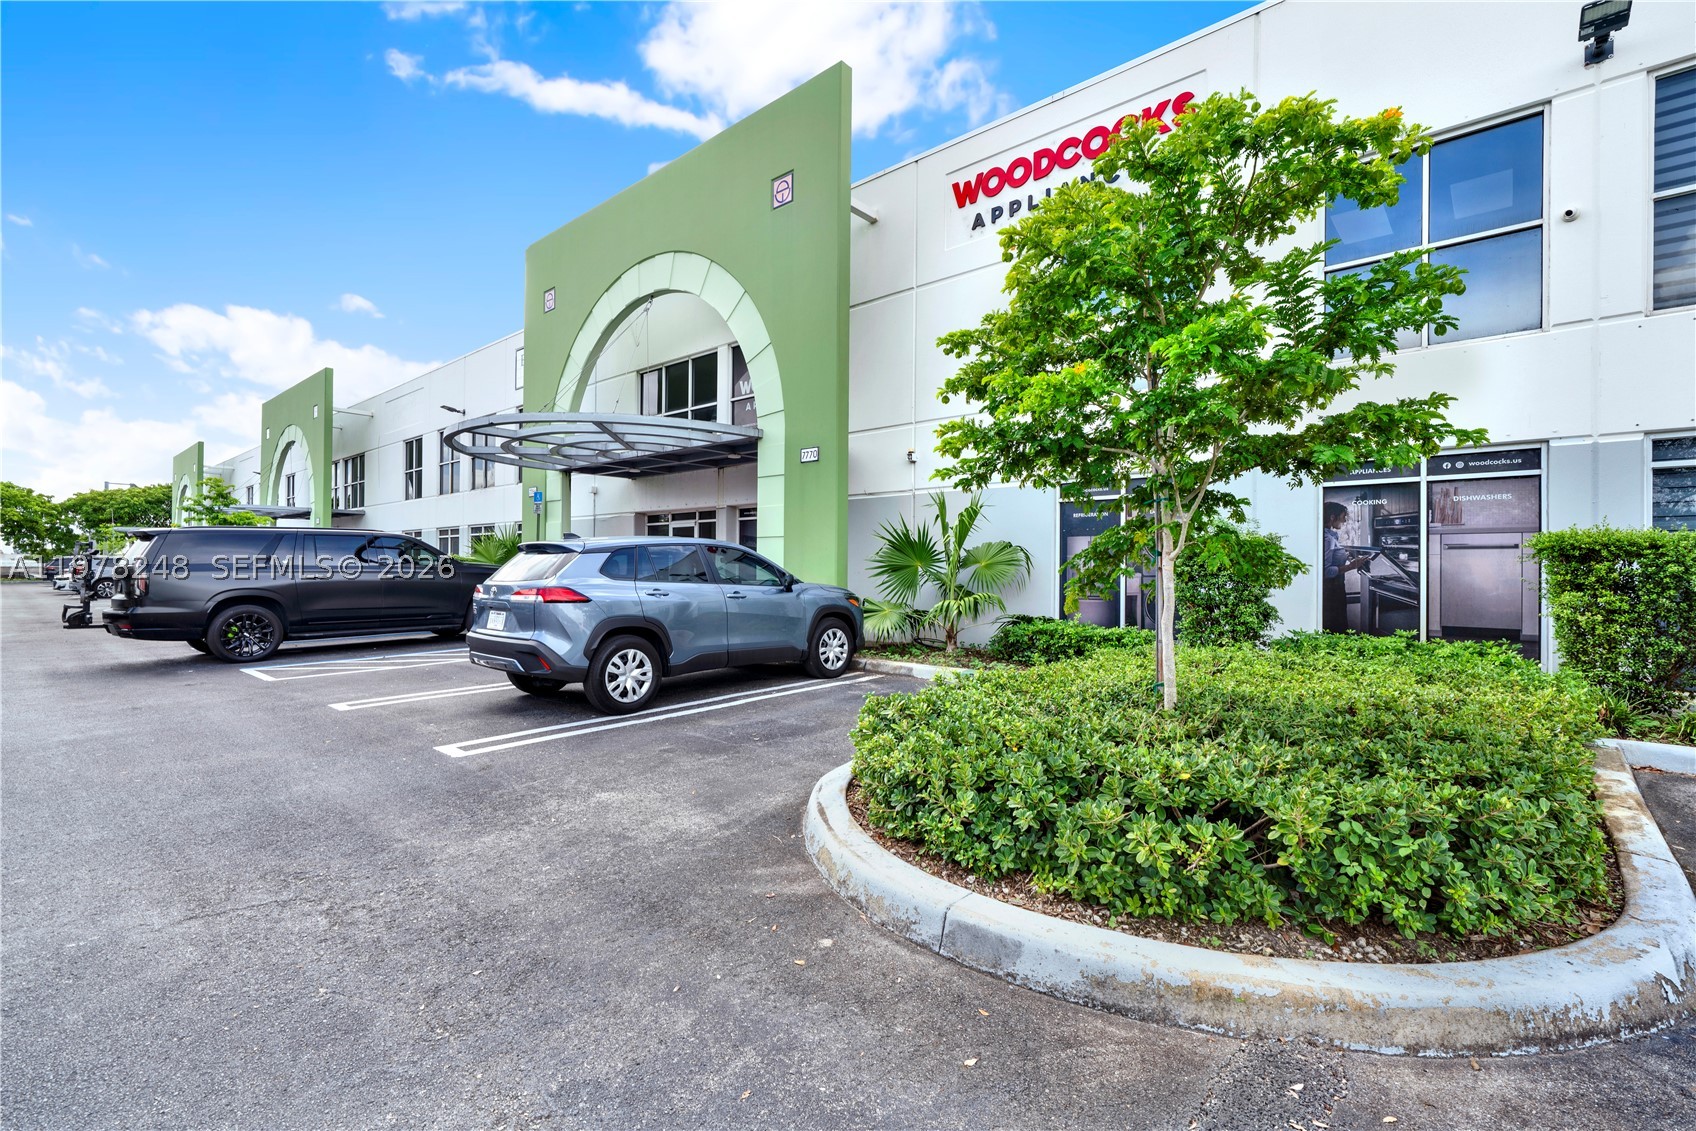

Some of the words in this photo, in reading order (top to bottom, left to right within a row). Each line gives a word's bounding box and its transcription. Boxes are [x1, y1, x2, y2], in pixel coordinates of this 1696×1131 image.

[801, 449, 818, 460] 7770
[1468, 458, 1522, 466] woodcocks.us
[1453, 493, 1513, 502] DISHWASHERS
